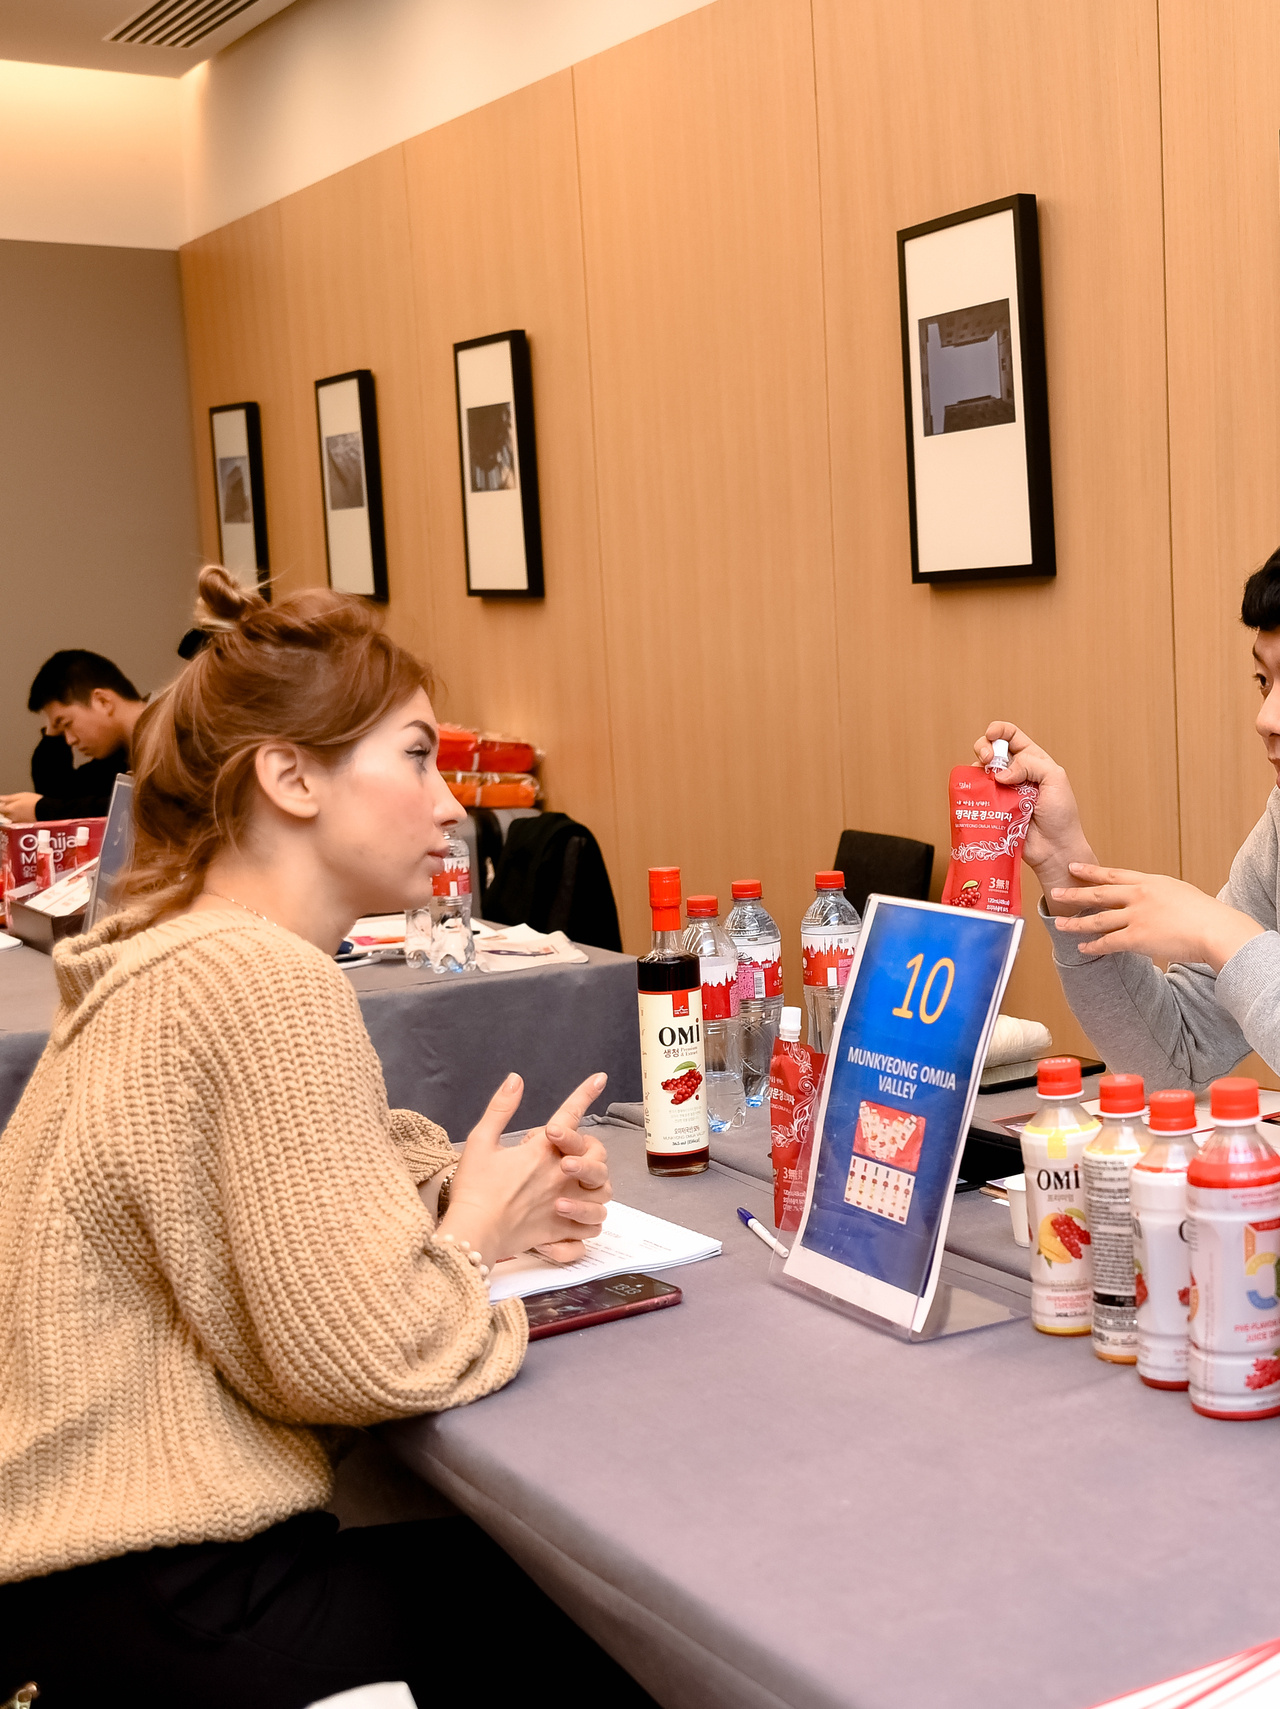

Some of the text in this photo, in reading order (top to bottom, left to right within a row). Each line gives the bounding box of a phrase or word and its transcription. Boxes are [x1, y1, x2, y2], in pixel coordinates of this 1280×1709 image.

[892, 953, 955, 1024] 10
[847, 1046, 956, 1091] MUNKYEONG OMIJA
[878, 1075, 918, 1100] VALLEY
